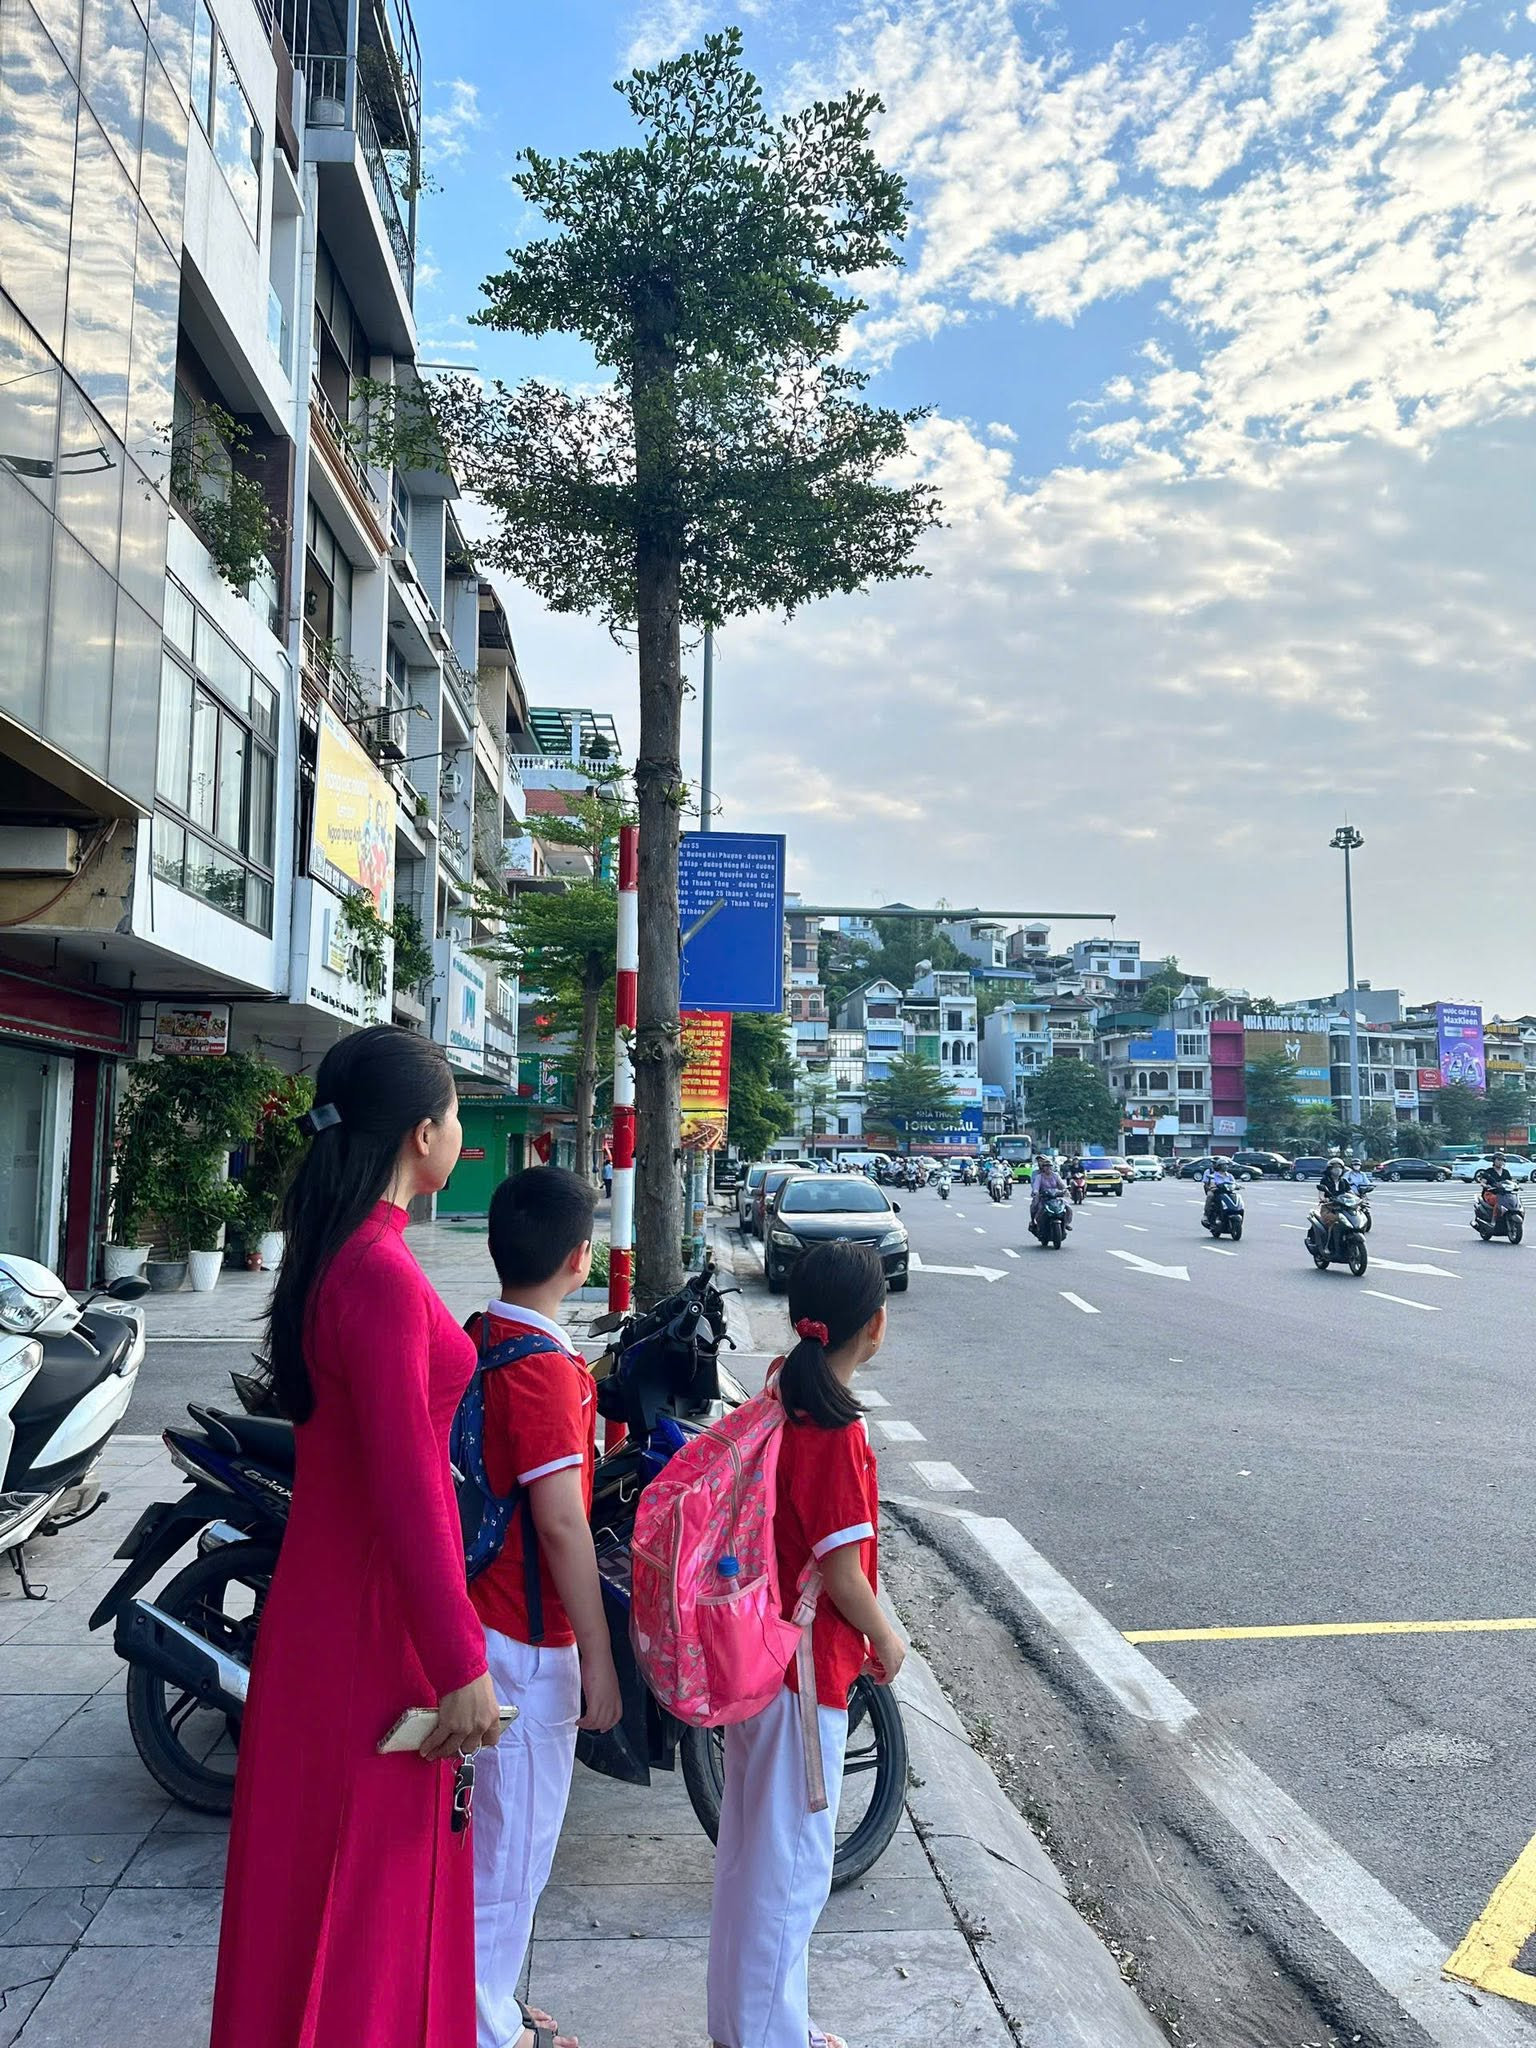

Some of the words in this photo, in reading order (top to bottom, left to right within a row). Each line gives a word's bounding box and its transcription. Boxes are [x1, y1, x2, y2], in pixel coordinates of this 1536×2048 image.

[1243, 1014, 1263, 1030] NHA
[1265, 1015, 1290, 1031] KHOA
[1444, 1016, 1478, 1026] MaxKleen
